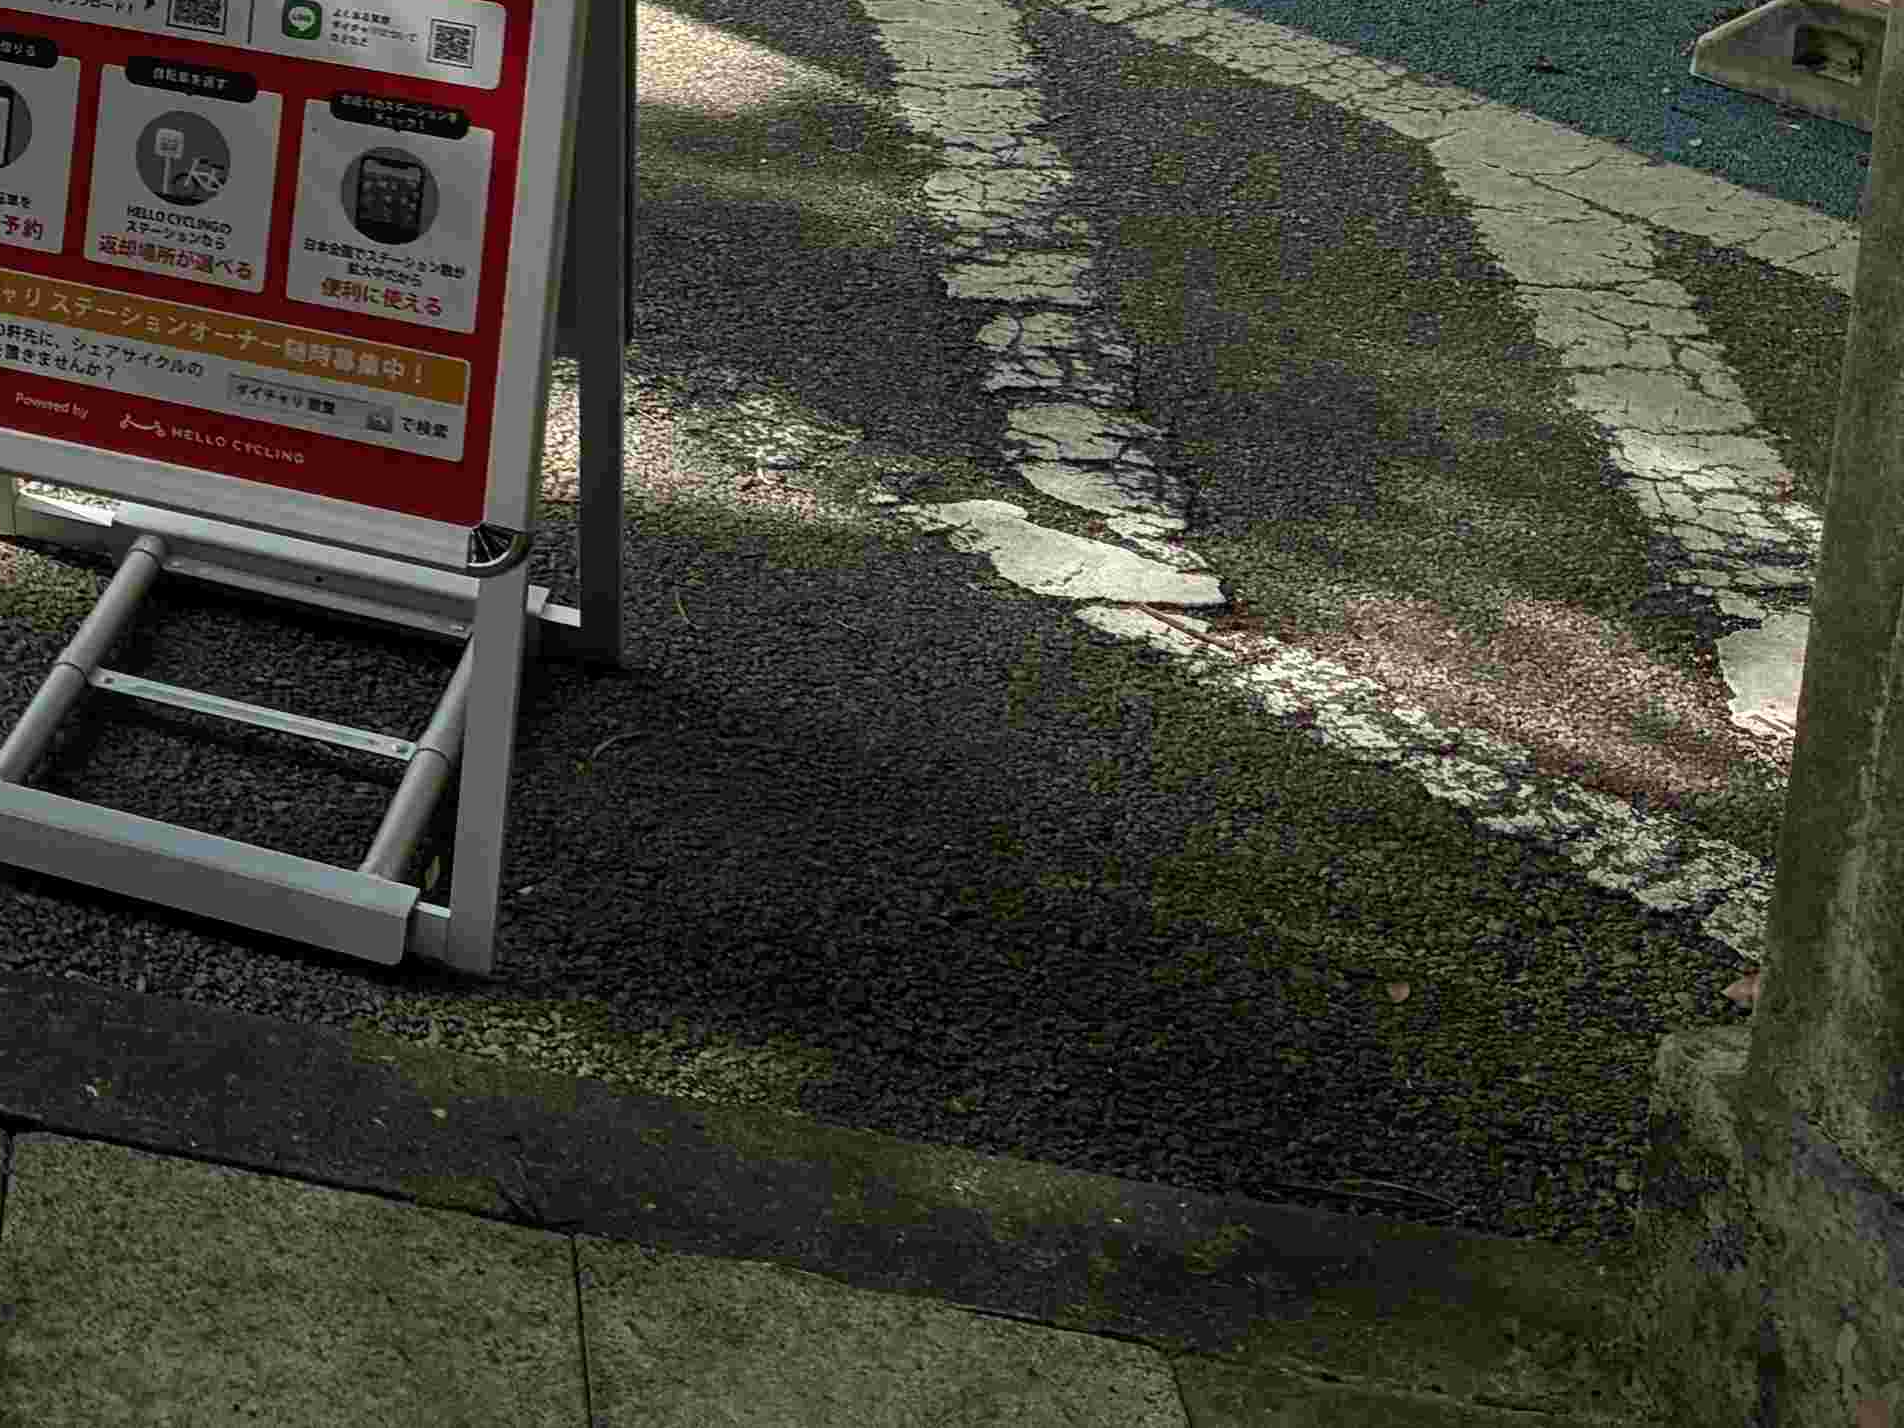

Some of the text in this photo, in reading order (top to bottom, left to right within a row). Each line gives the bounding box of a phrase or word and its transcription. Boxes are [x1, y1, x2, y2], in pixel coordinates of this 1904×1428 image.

[15, 392, 89, 420] Powered by
[171, 429, 305, 465] HELLO CYCLING
